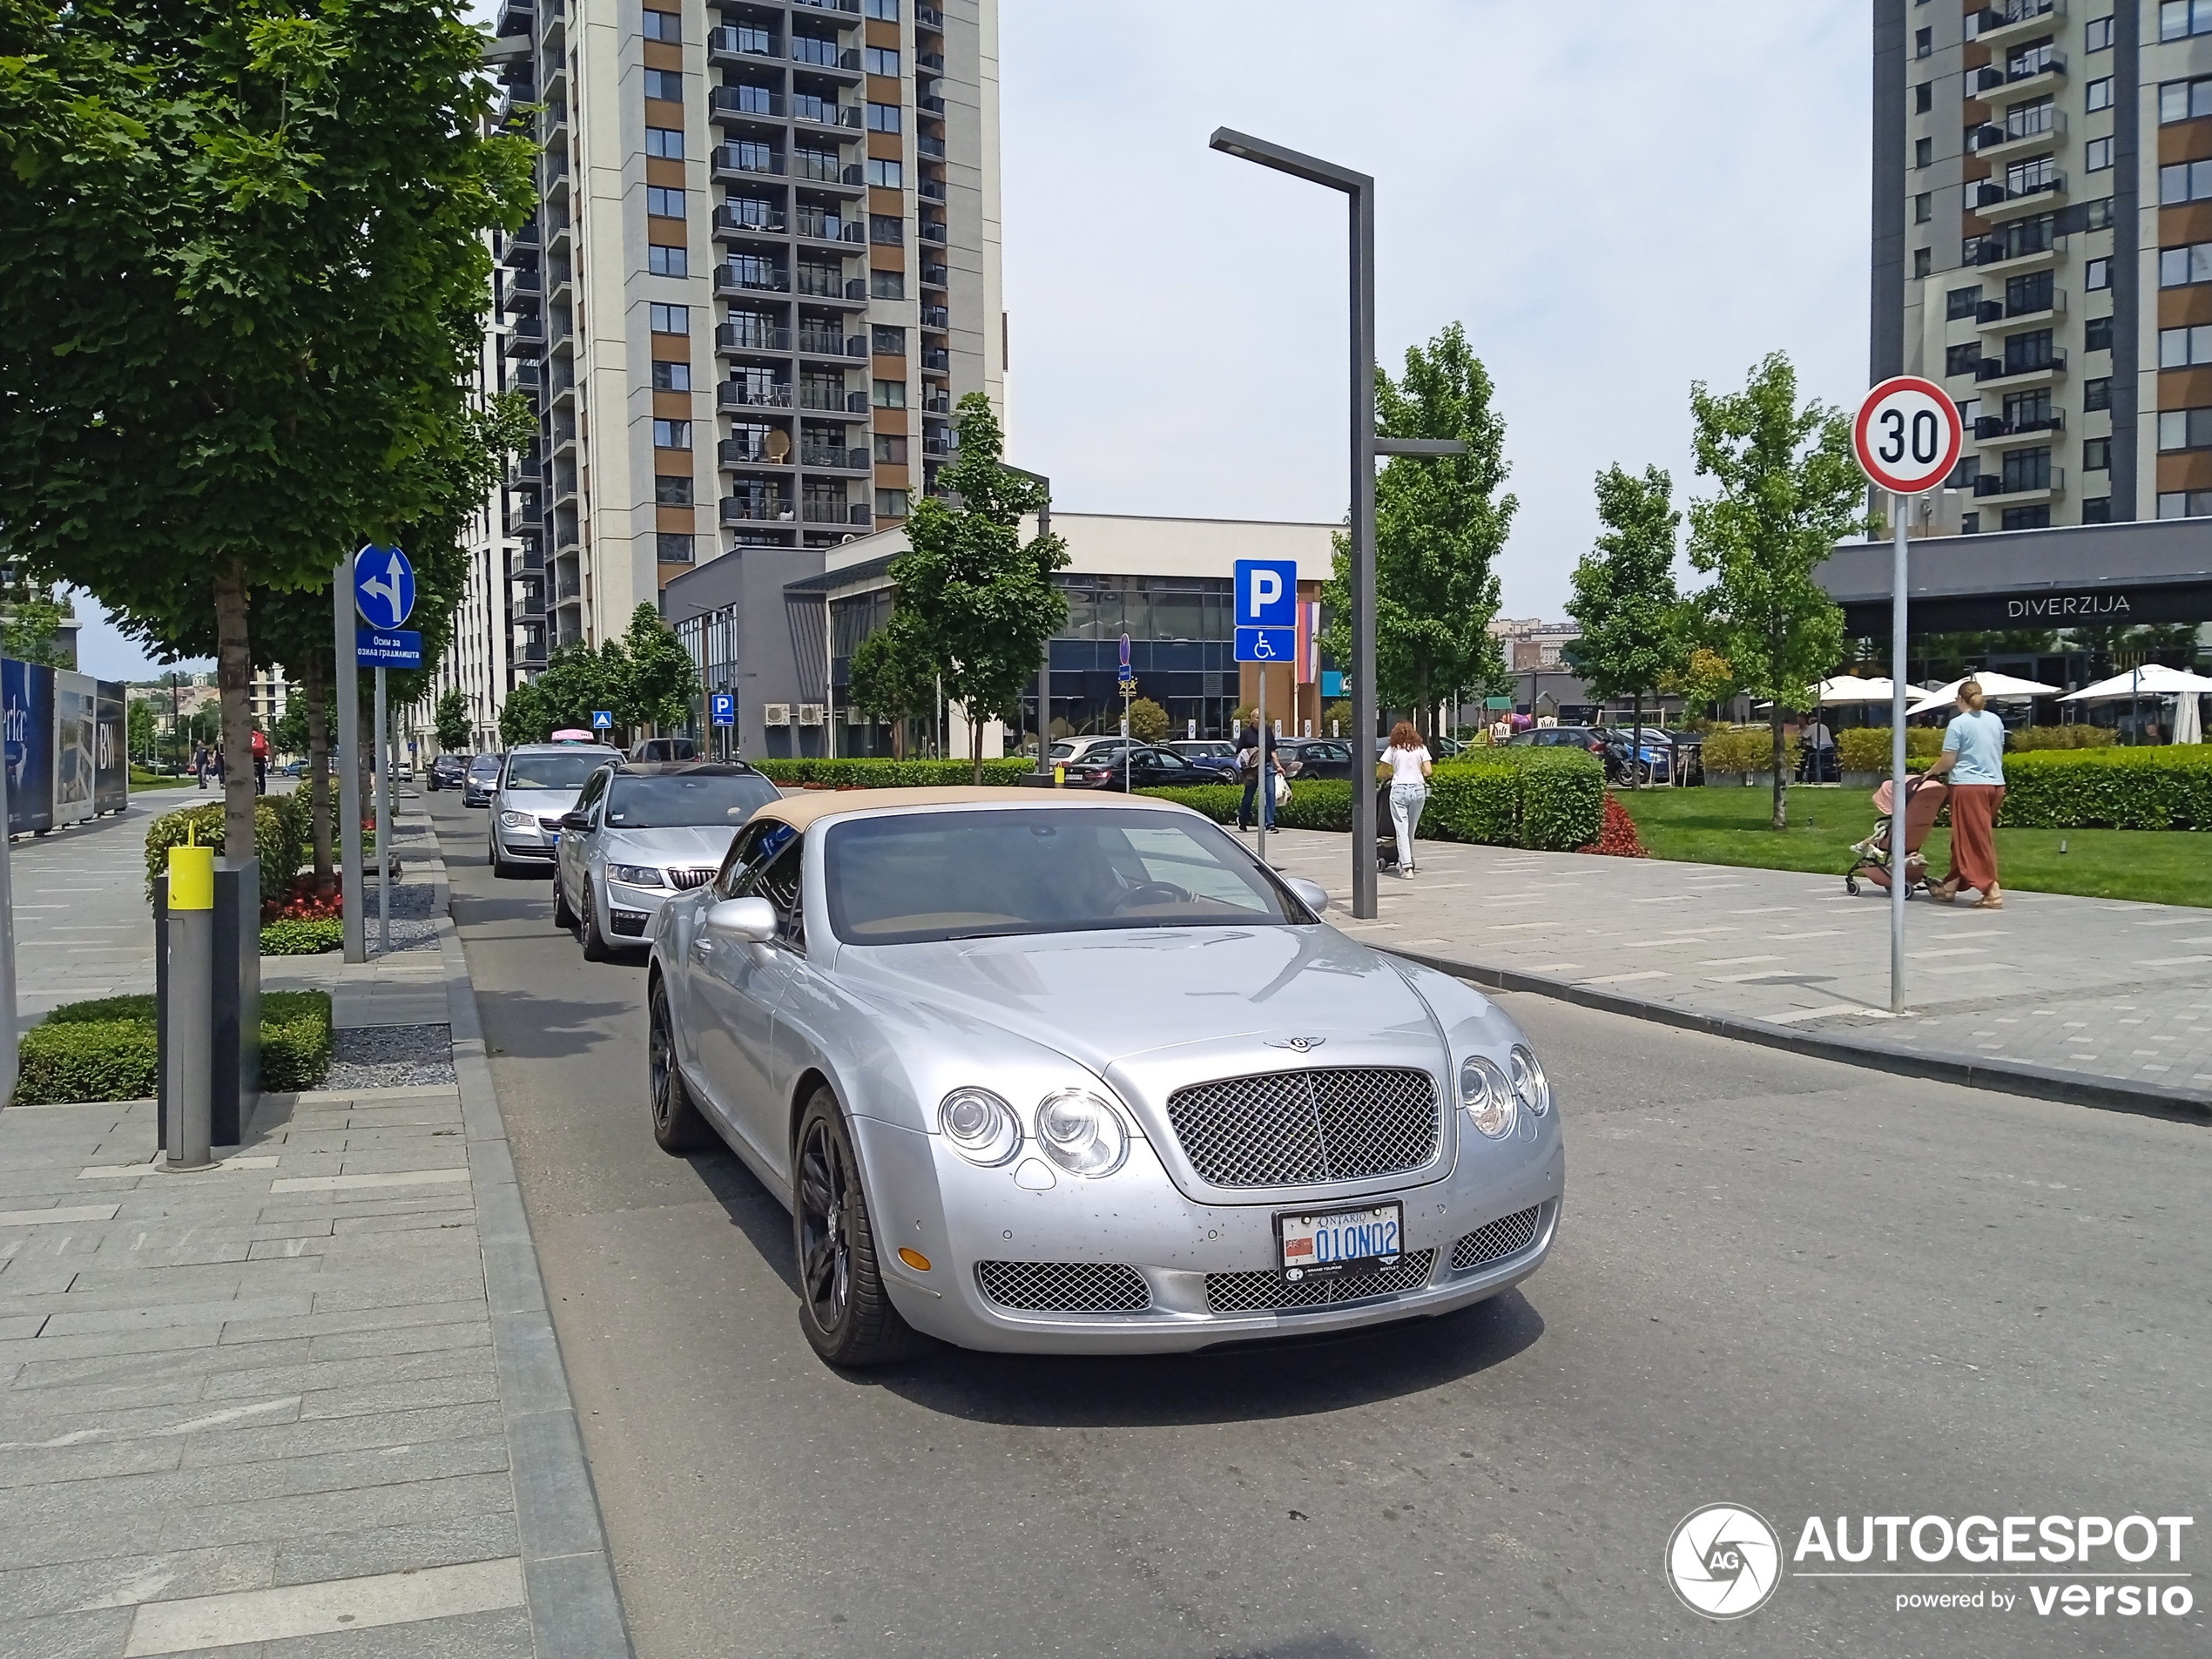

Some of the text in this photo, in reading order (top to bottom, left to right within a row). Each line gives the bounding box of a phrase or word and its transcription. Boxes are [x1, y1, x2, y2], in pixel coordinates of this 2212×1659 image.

[1879, 408, 1938, 464] 30
[1250, 569, 1283, 617] P
[2007, 595, 2130, 617] DIVERZIJA
[374, 636, 391, 646] Осим
[717, 698, 729, 713] P
[1318, 1212, 1366, 1229] ONTARIO
